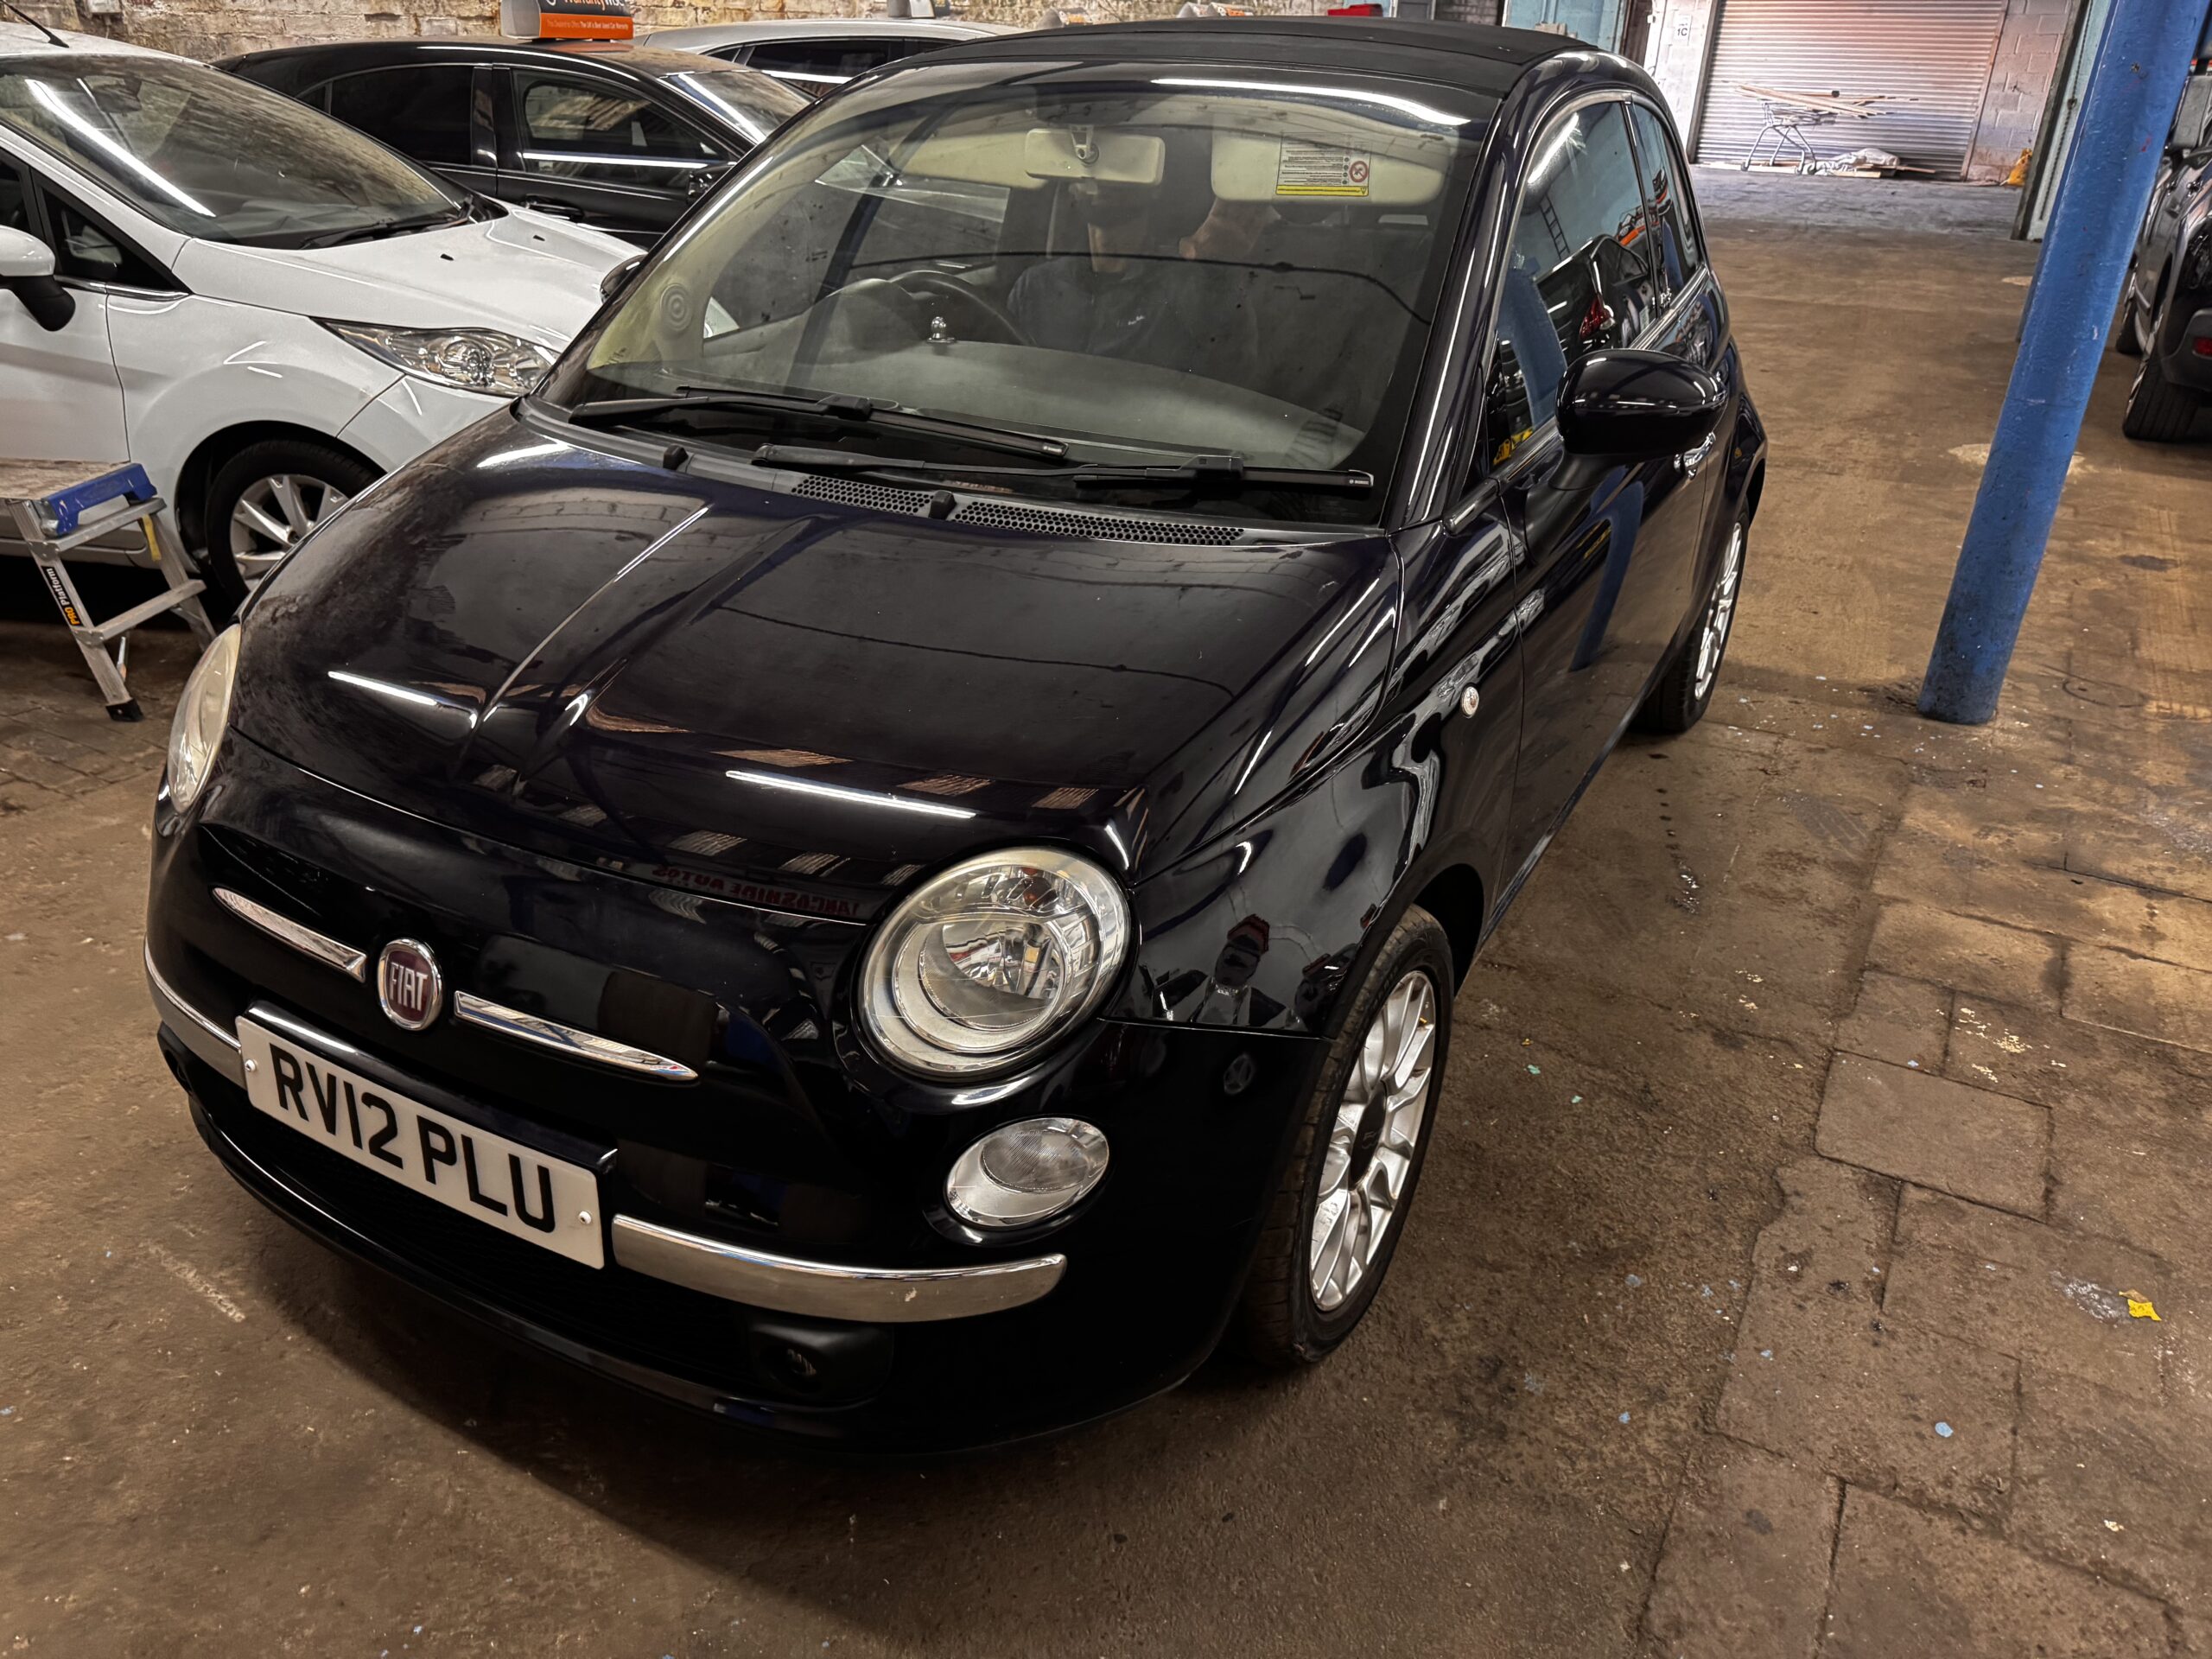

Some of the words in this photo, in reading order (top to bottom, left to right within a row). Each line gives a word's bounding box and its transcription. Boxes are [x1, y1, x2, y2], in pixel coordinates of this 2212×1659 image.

[1677, 28, 1688, 36] 1C
[47, 568, 70, 606] Platform
[65, 607, 80, 625] PRO
[390, 962, 429, 1011] FIAT
[270, 1043, 404, 1169] RV12
[416, 1115, 556, 1234] PLU
